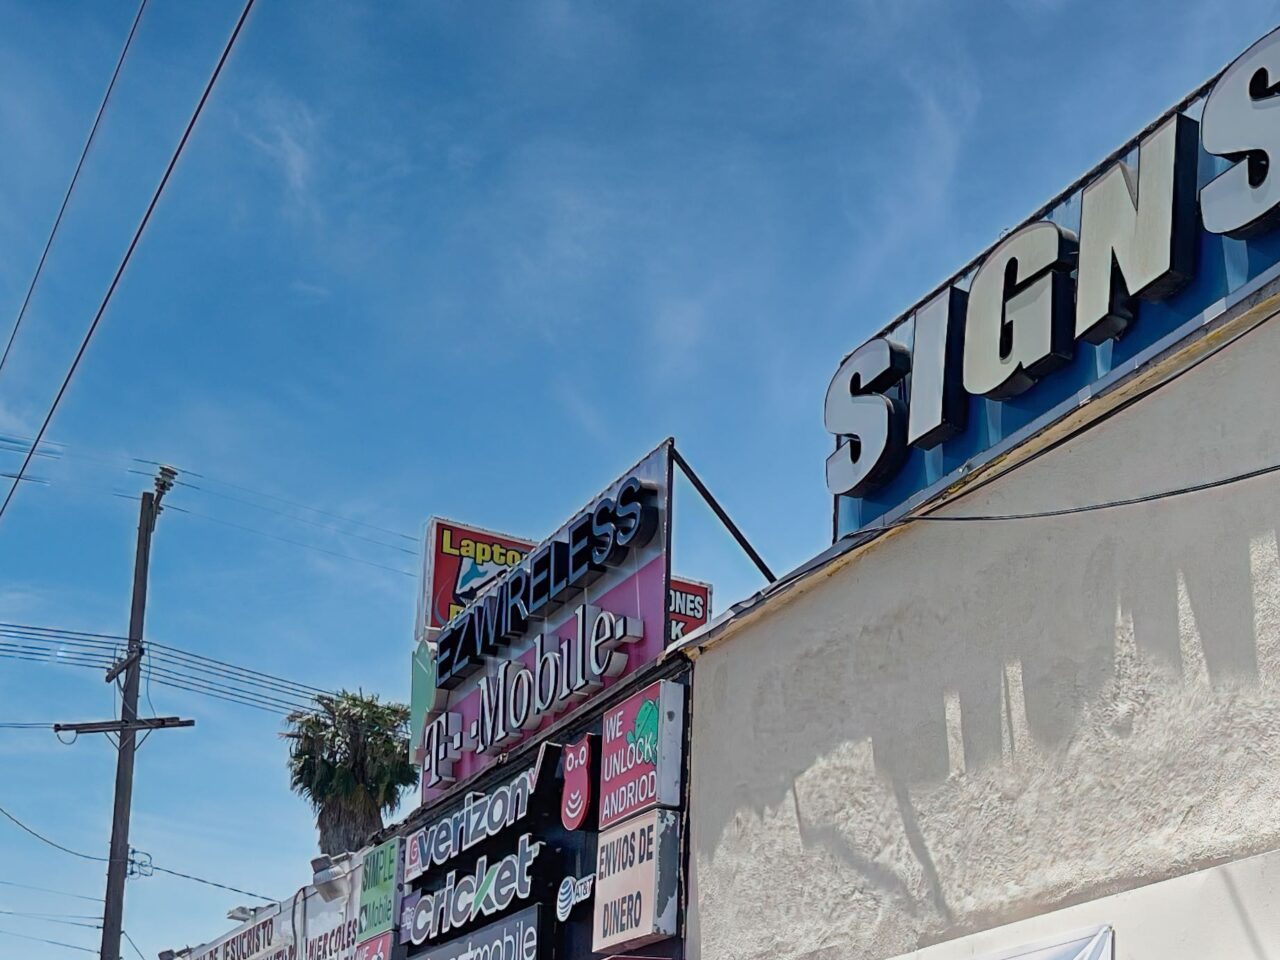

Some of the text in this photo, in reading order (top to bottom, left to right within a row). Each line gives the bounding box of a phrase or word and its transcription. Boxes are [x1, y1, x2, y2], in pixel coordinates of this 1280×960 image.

[442, 529, 528, 567] Lapto
[670, 589, 704, 619] ONES
[606, 711, 624, 743] WE
[604, 734, 656, 782] UNLOCK
[602, 771, 656, 820] ANDRIOD
[417, 768, 532, 870] verizon
[599, 836, 635, 878] ENVIOS
[637, 825, 654, 865] DE
[362, 845, 395, 893] SIMPLE
[411, 834, 538, 944] cricket
[575, 877, 595, 897] AT&T
[368, 895, 392, 930] Mobile
[602, 892, 642, 939] DINERO
